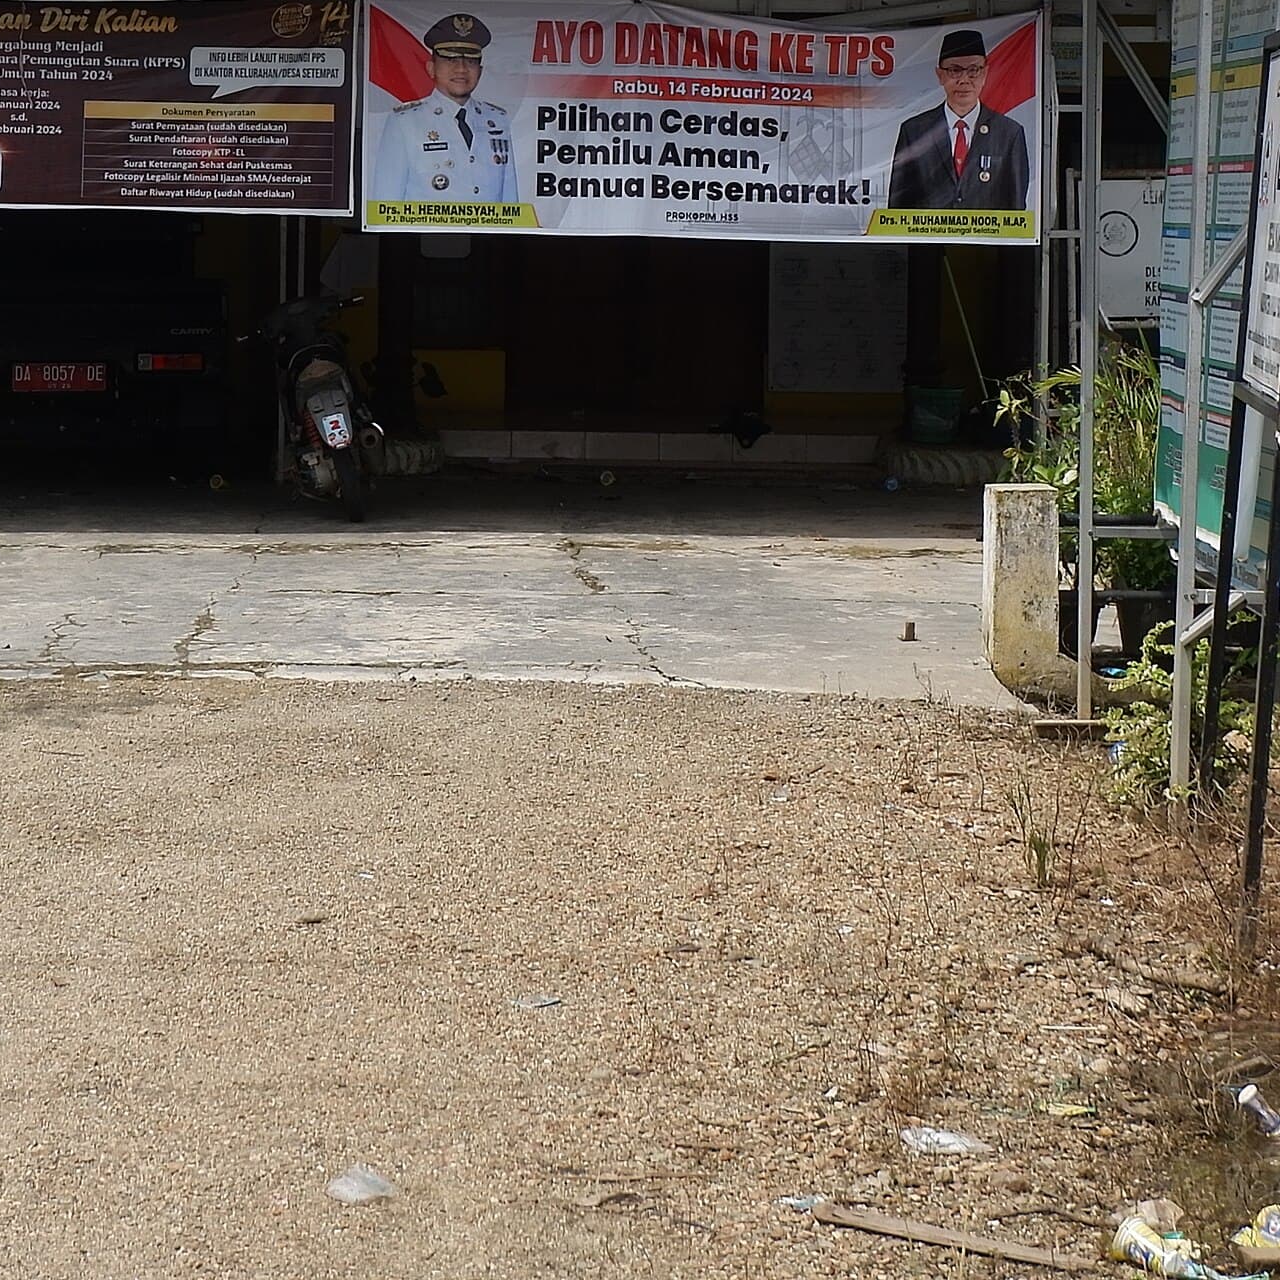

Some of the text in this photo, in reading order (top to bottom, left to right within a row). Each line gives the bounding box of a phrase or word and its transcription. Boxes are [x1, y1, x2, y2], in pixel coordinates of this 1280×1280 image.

[39, 7, 90, 33] Diri
[94, 8, 178, 35] Kalian
[55, 40, 104, 53] Menjadi
[531, 20, 895, 78] AYO DATANG KE TPS
[21, 54, 100, 68] Pemungutan
[104, 56, 139, 67] Suara
[143, 57, 186, 70] (KPPS)
[209, 53, 325, 63] INFO LEBIH LANJUT HUBUNGI PPS
[39, 69, 78, 80] Tahun
[82, 70, 113, 81] 2024
[195, 68, 339, 78] DI KANTOR KELURAHAN/DESA SETEMPAT
[20, 88, 49, 99] kerja:
[613, 80, 813, 102] Rabu, 14 Februari 2024
[35, 101, 60, 110] 2024
[10, 113, 28, 121] s.d.
[162, 108, 256, 119] Dokumen Persyaratan
[130, 122, 287, 133] Surat Pernyataan (sudah disediakan)
[537, 103, 789, 142] Pilihan Cerdas,
[36, 125, 62, 134] 2024
[129, 135, 289, 145] Surat Pendaftaran (sudah disediakan)
[173, 148, 212, 158] Fotocopy
[215, 148, 231, 157] KTP
[536, 137, 770, 173] Pemilu Aman,
[124, 160, 293, 171] Surat Keterangan Sehat dari Puskesmas
[104, 172, 312, 184] Fotocopy Legalisir Minimal Ijazah SMA/sederajat
[120, 188, 295, 200] Daftar Riwayat Hidup (sudah disediakan)
[536, 172, 871, 205] Banua Bersemarak!
[379, 204, 521, 218] Drs. H. HERMANSYAH, MM
[666, 211, 739, 221] PROKOPIM HSS
[400, 216, 428, 225] Bupati
[450, 217, 479, 225] Sungai
[481, 217, 513, 225] Selatan
[879, 215, 898, 225] Drs.
[900, 215, 910, 225] H.
[912, 216, 969, 226] MUHAMMAD
[971, 216, 1001, 228] NOOR,
[947, 227, 972, 235] Sungai
[15, 365, 103, 381] DA 8057 DE
